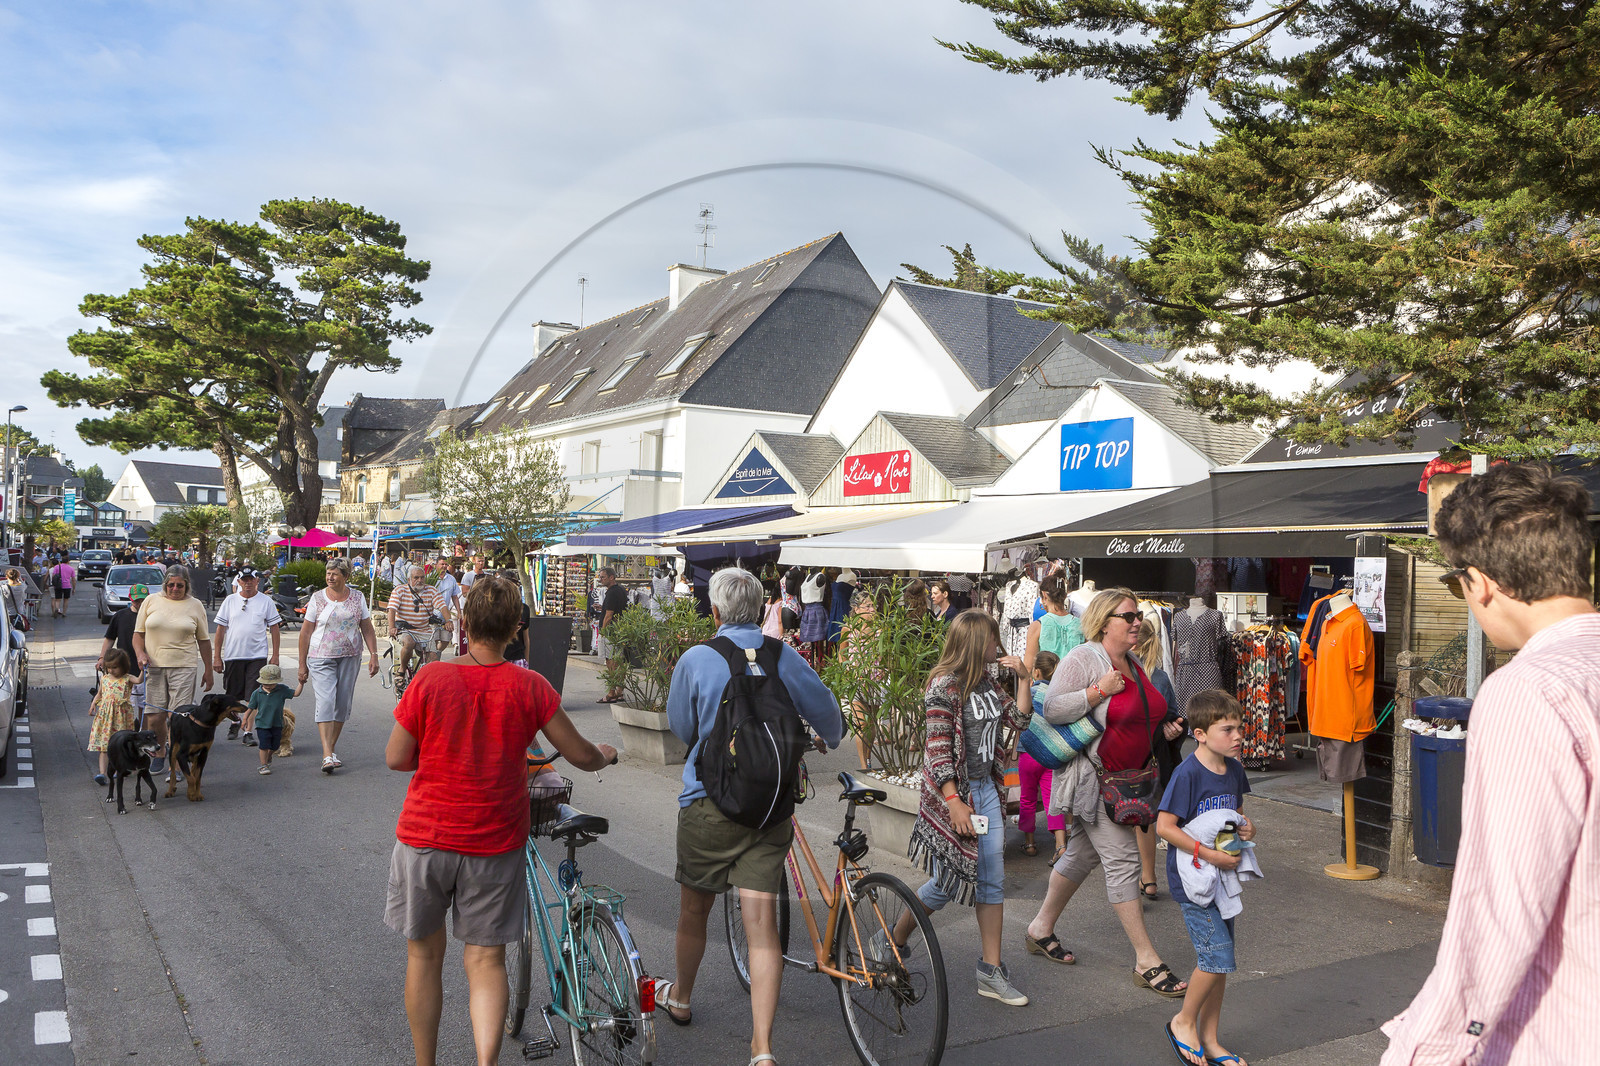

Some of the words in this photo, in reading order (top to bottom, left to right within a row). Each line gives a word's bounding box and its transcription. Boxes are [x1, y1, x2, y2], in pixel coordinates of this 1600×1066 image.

[1371, 396, 1388, 414] et
[1062, 443, 1091, 471] TIP
[1094, 440, 1130, 469] TOP
[1284, 438, 1322, 458] Femme
[735, 468, 748, 480] Esprit
[748, 468, 756, 477] de
[756, 467, 762, 477] la
[762, 466, 773, 476] Mer
[884, 453, 910, 493] Rose
[1106, 537, 1131, 556] Côte
[1133, 540, 1145, 553] et
[1145, 537, 1185, 554] Maille
